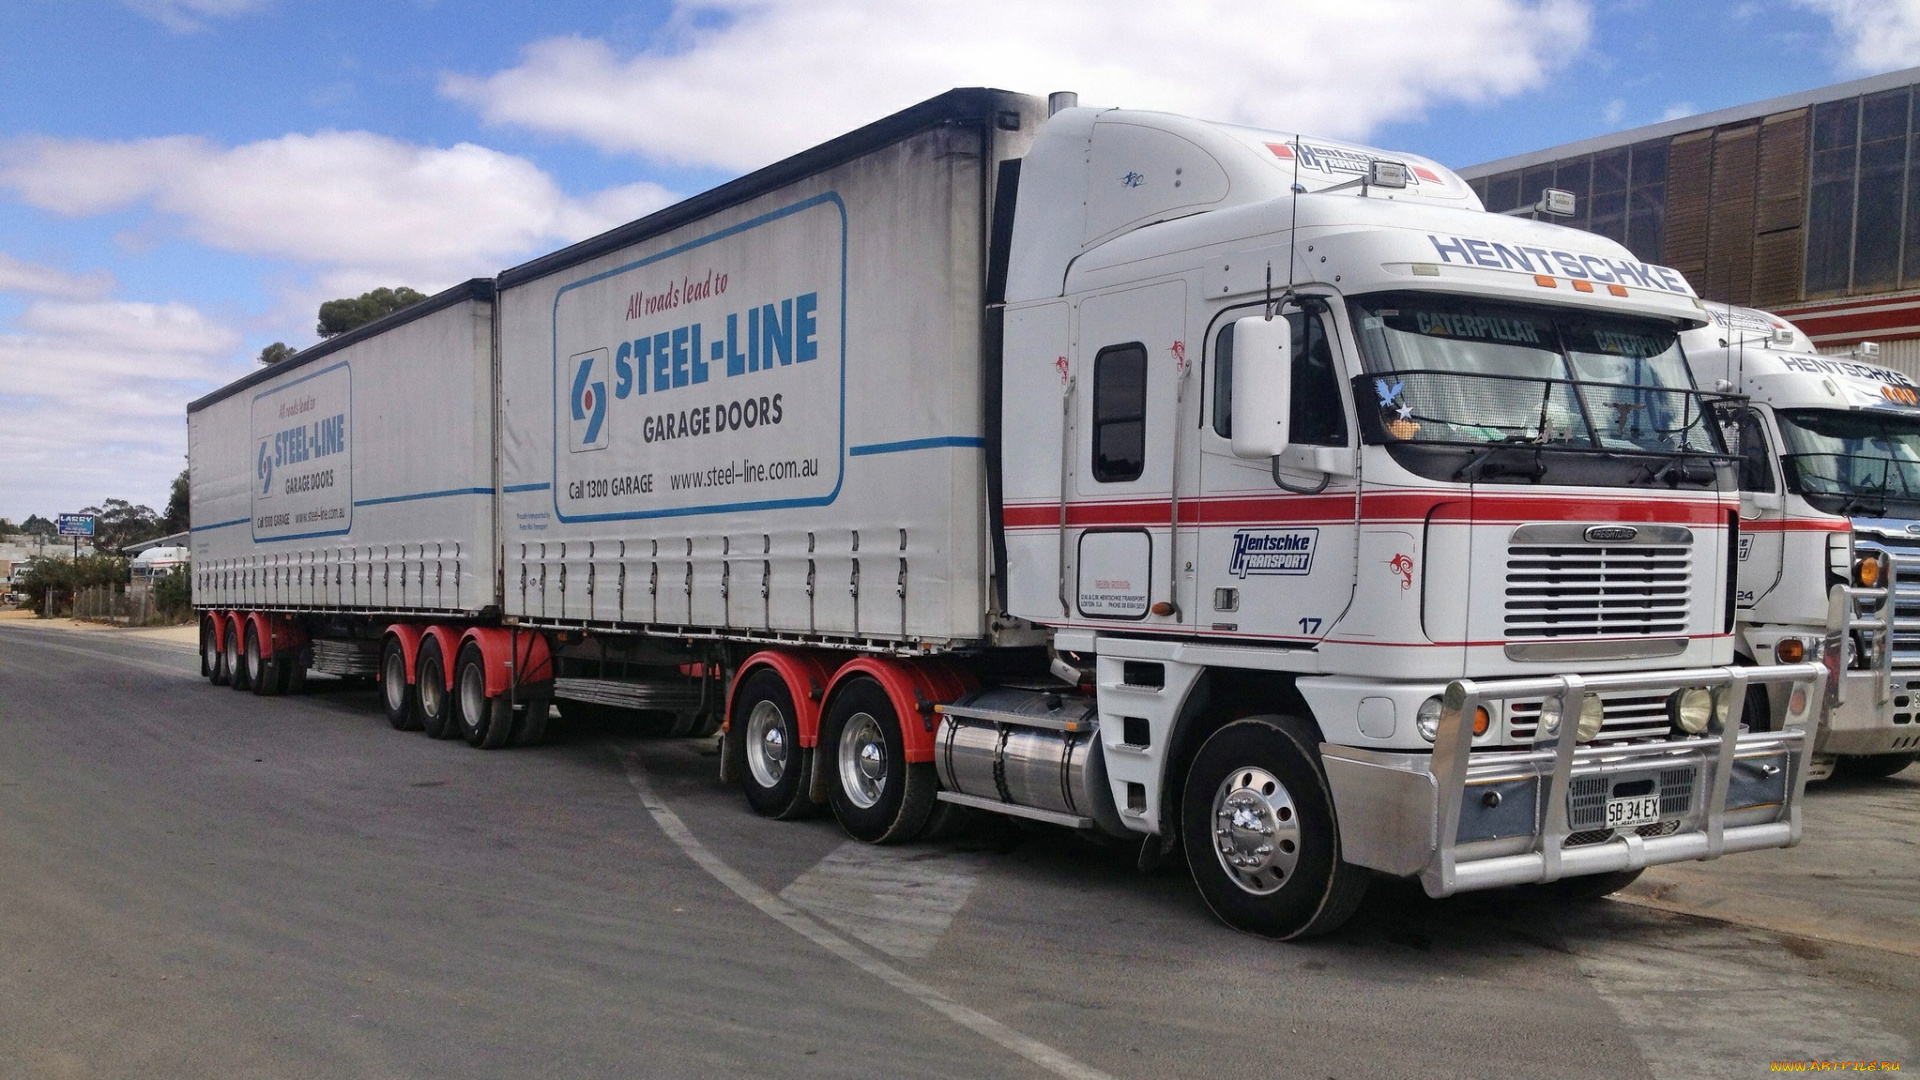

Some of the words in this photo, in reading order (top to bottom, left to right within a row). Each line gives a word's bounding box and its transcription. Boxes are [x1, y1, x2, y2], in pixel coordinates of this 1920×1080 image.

[1315, 158, 1370, 174] TRANS
[1427, 235, 1687, 293] HENTSCHKE
[626, 291, 642, 321] All
[645, 281, 679, 315] roads
[683, 268, 711, 305] lead
[715, 273, 728, 296] to
[1415, 312, 1540, 343] CATERPILLAR
[615, 292, 817, 399] STEEL-LINE
[1779, 356, 1912, 387] HENTSCHKE
[643, 407, 710, 443] GARAGE
[715, 393, 783, 432] DOORS
[275, 414, 344, 468] STEEL-LINE
[285, 475, 310, 495] GARAGE
[311, 469, 333, 491] DOORS
[569, 482, 584, 499] Call
[587, 479, 608, 498] 1300
[612, 474, 653, 496] GARAGE
[671, 458, 818, 490] www.steel-line.com.au
[274, 513, 290, 526] GARAGE
[1232, 534, 1310, 570] Hentschke
[1239, 554, 1308, 579] TRANSPORT
[1737, 591, 1754, 601] 24
[1298, 618, 1322, 634] 17
